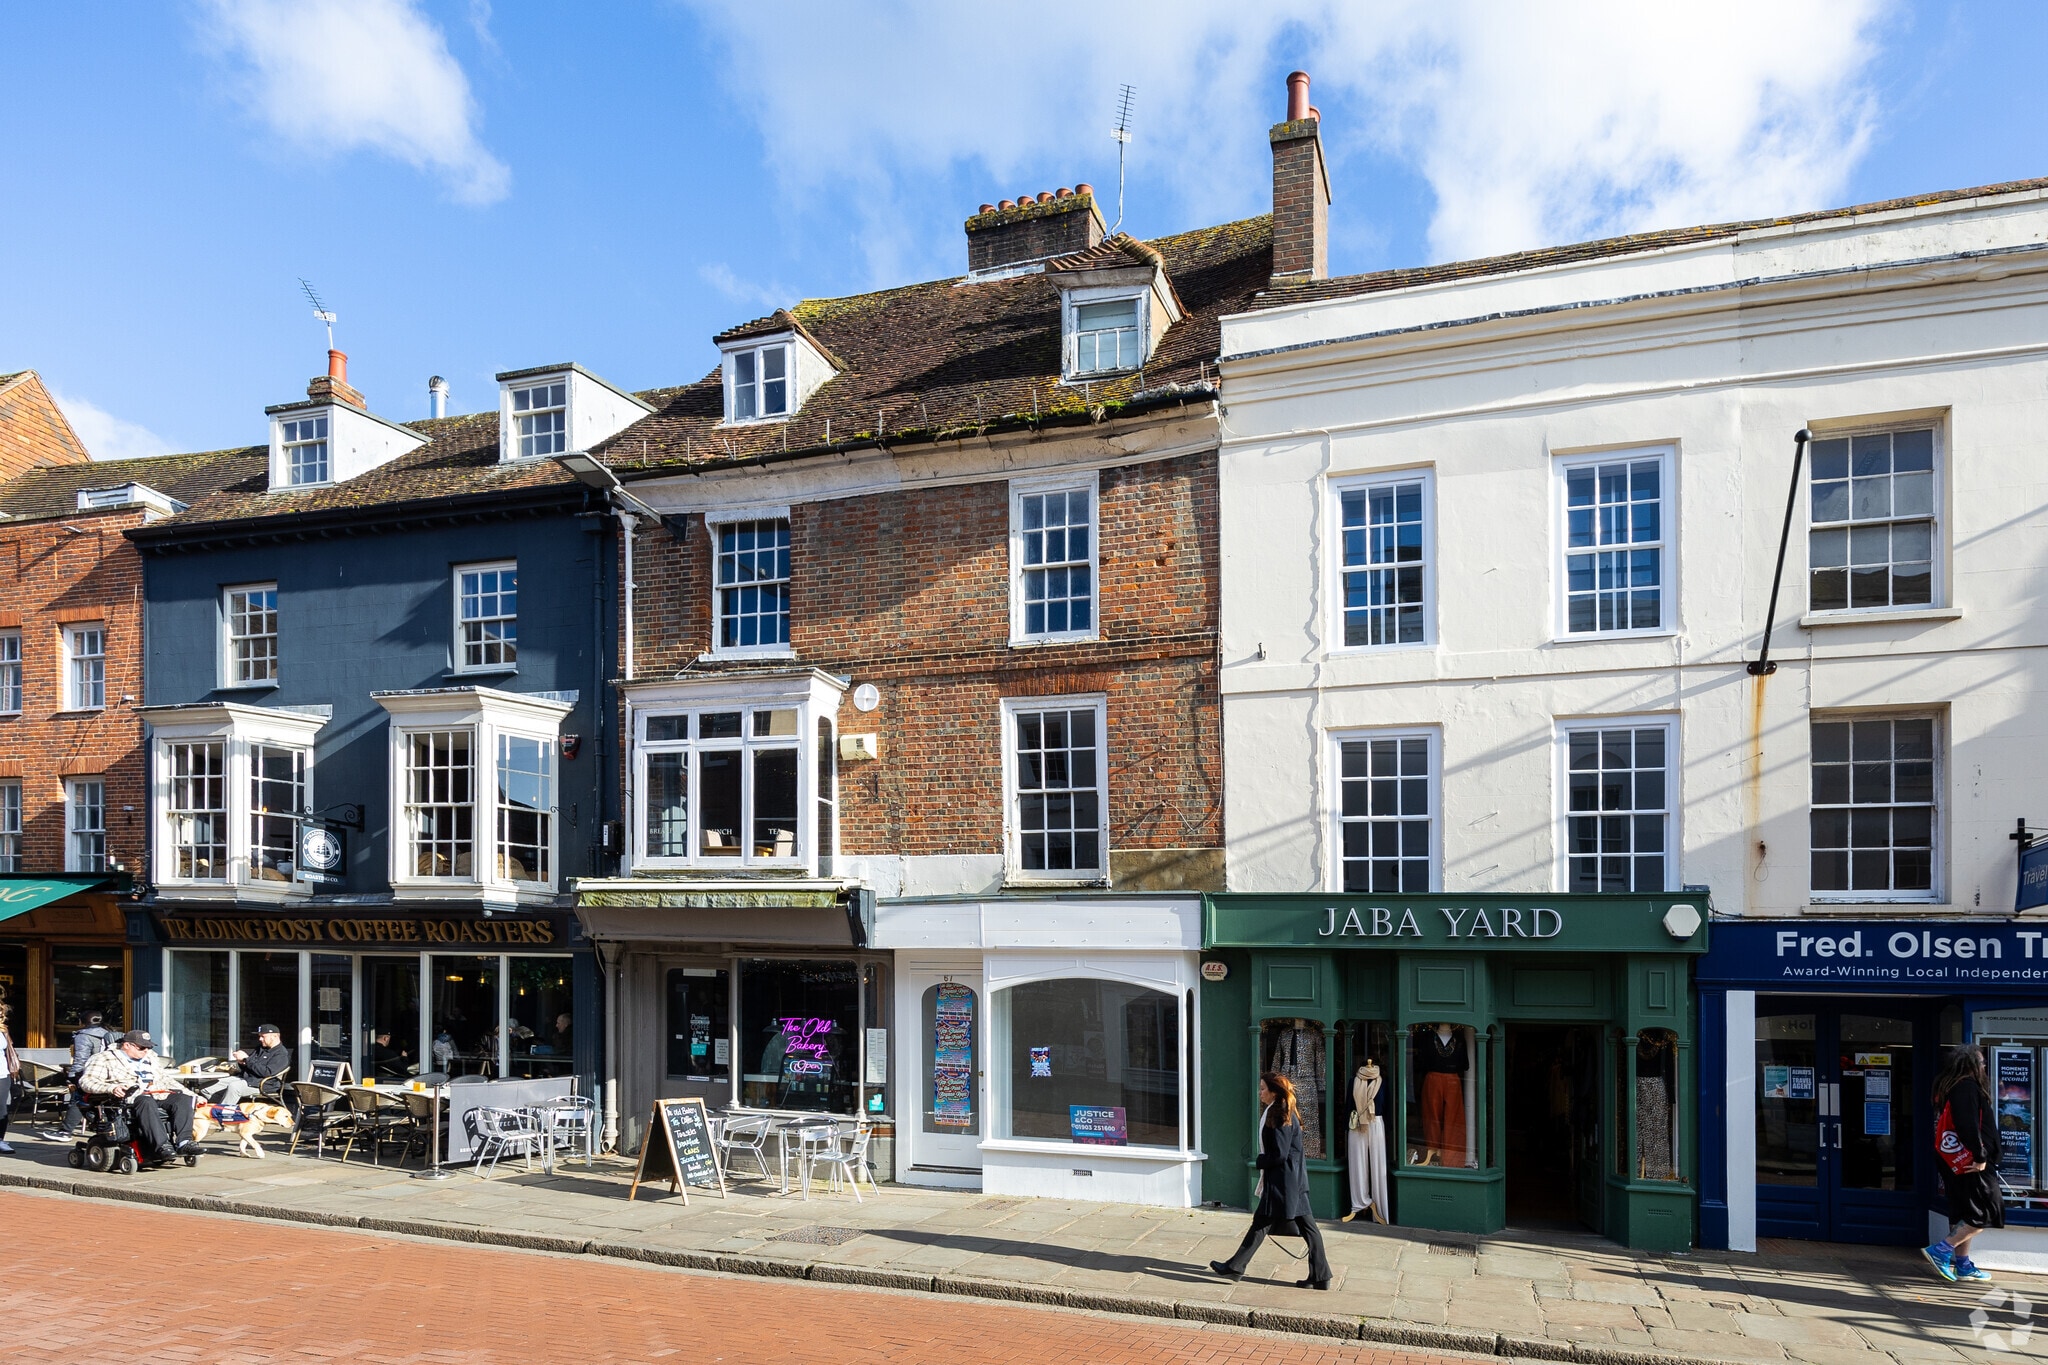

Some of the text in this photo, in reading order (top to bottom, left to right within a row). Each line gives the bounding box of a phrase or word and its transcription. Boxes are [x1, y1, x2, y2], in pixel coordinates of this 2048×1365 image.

[2024, 866, 2048, 886] Travel
[161, 919, 555, 943] TRADING POST COFFEE ROASTERS
[1318, 907, 1563, 938] JABA YARD
[1776, 931, 1873, 958] Fred.
[1888, 931, 2002, 958] Olsen
[1783, 966, 1899, 978] Award-Winning
[1907, 967, 1948, 977] Local
[779, 1018, 832, 1038] The Old
[785, 1036, 828, 1058] Bakery
[794, 1060, 821, 1074] Open
[1074, 1110, 1114, 1118] JUSTICE
